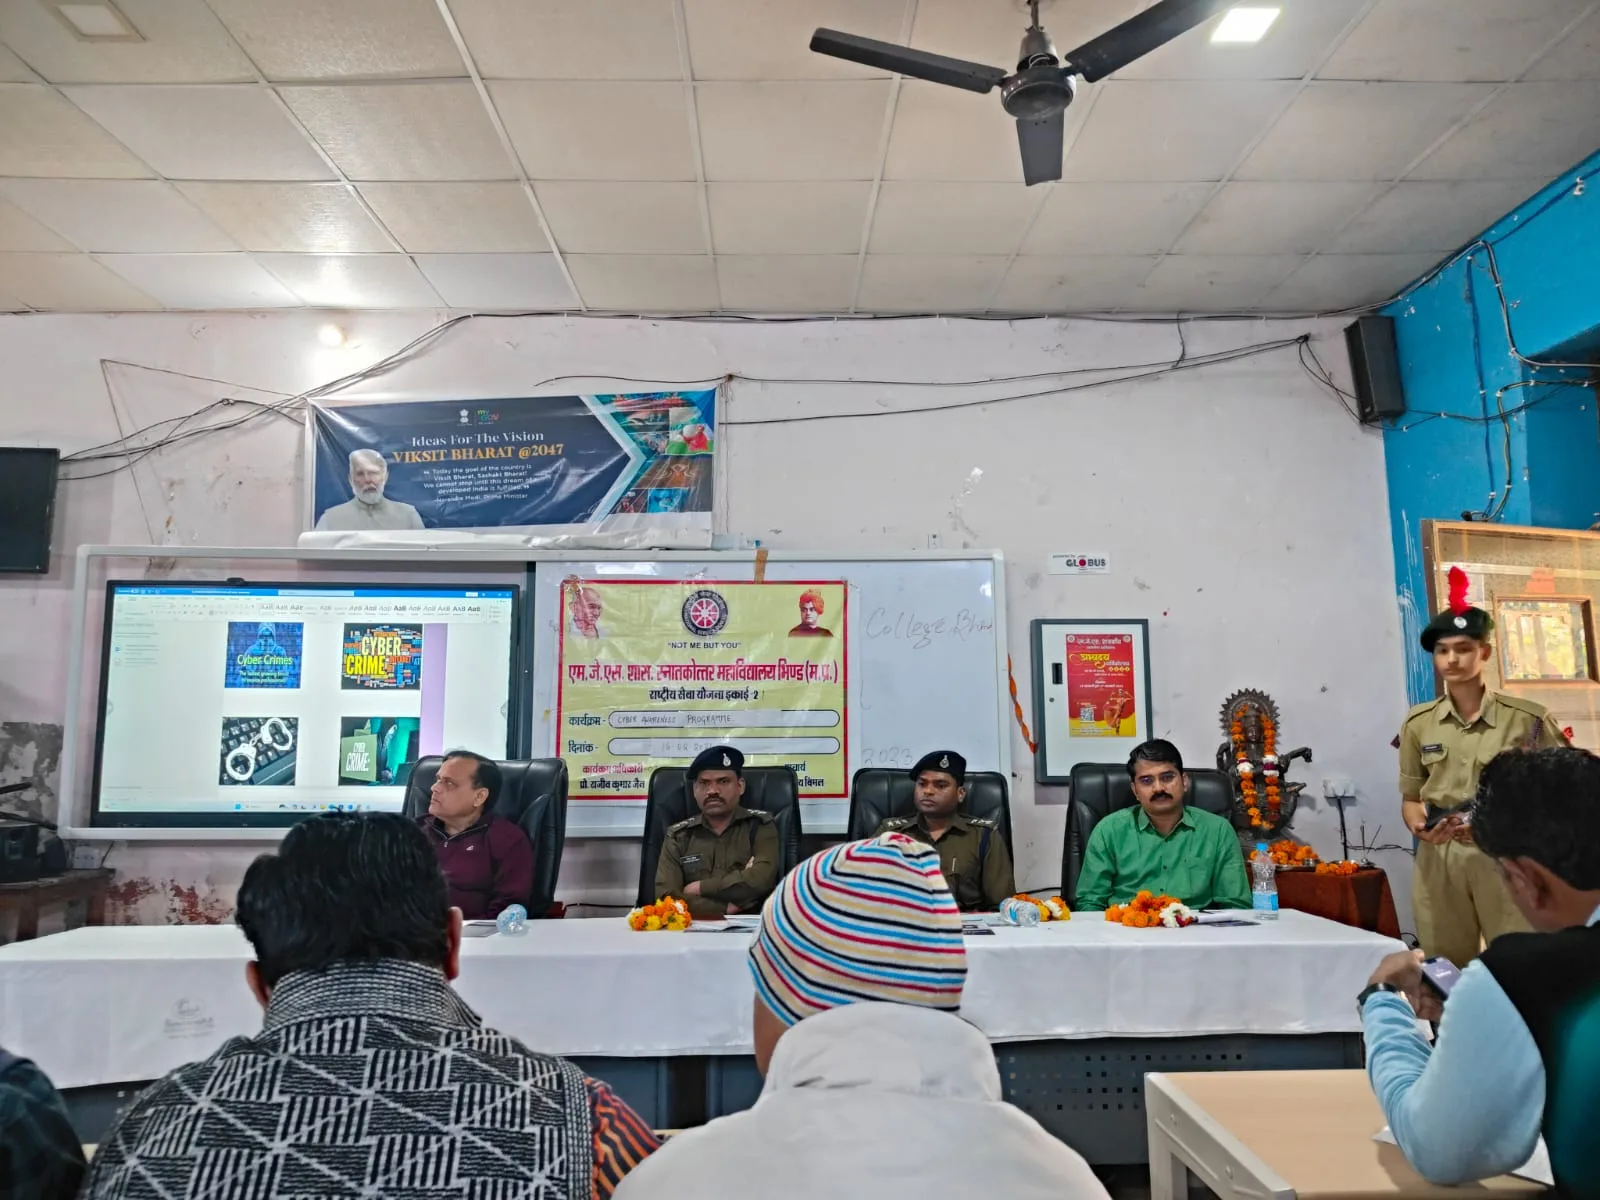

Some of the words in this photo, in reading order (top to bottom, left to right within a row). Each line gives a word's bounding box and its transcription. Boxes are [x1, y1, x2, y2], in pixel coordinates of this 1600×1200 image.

[412, 436, 447, 447] Ideas
[450, 434, 473, 446] For
[475, 433, 500, 444] The
[501, 431, 544, 442] Vision
[392, 449, 448, 463] VIKSIT
[452, 446, 516, 461] BHARAT
[518, 443, 564, 460] @2047
[1065, 559, 1106, 567] GLOBUS
[865, 607, 946, 650] College
[361, 637, 402, 656] CYBER
[237, 654, 262, 666] Cyber
[263, 654, 293, 665] Crimes
[346, 655, 386, 676] CRIME
[656, 658, 715, 681] स्नातकोत्तर
[717, 658, 776, 681] महाविद्यालय
[778, 658, 804, 681] भिण्ड
[649, 686, 676, 702] राष्ट्रीय
[678, 686, 695, 700] सेवा
[697, 686, 723, 700] योजना
[726, 686, 749, 701] इकाई
[346, 752, 369, 772] CRIME
[590, 778, 611, 789] राजीव
[612, 780, 631, 791] कुमार
[632, 778, 646, 789] जैन
